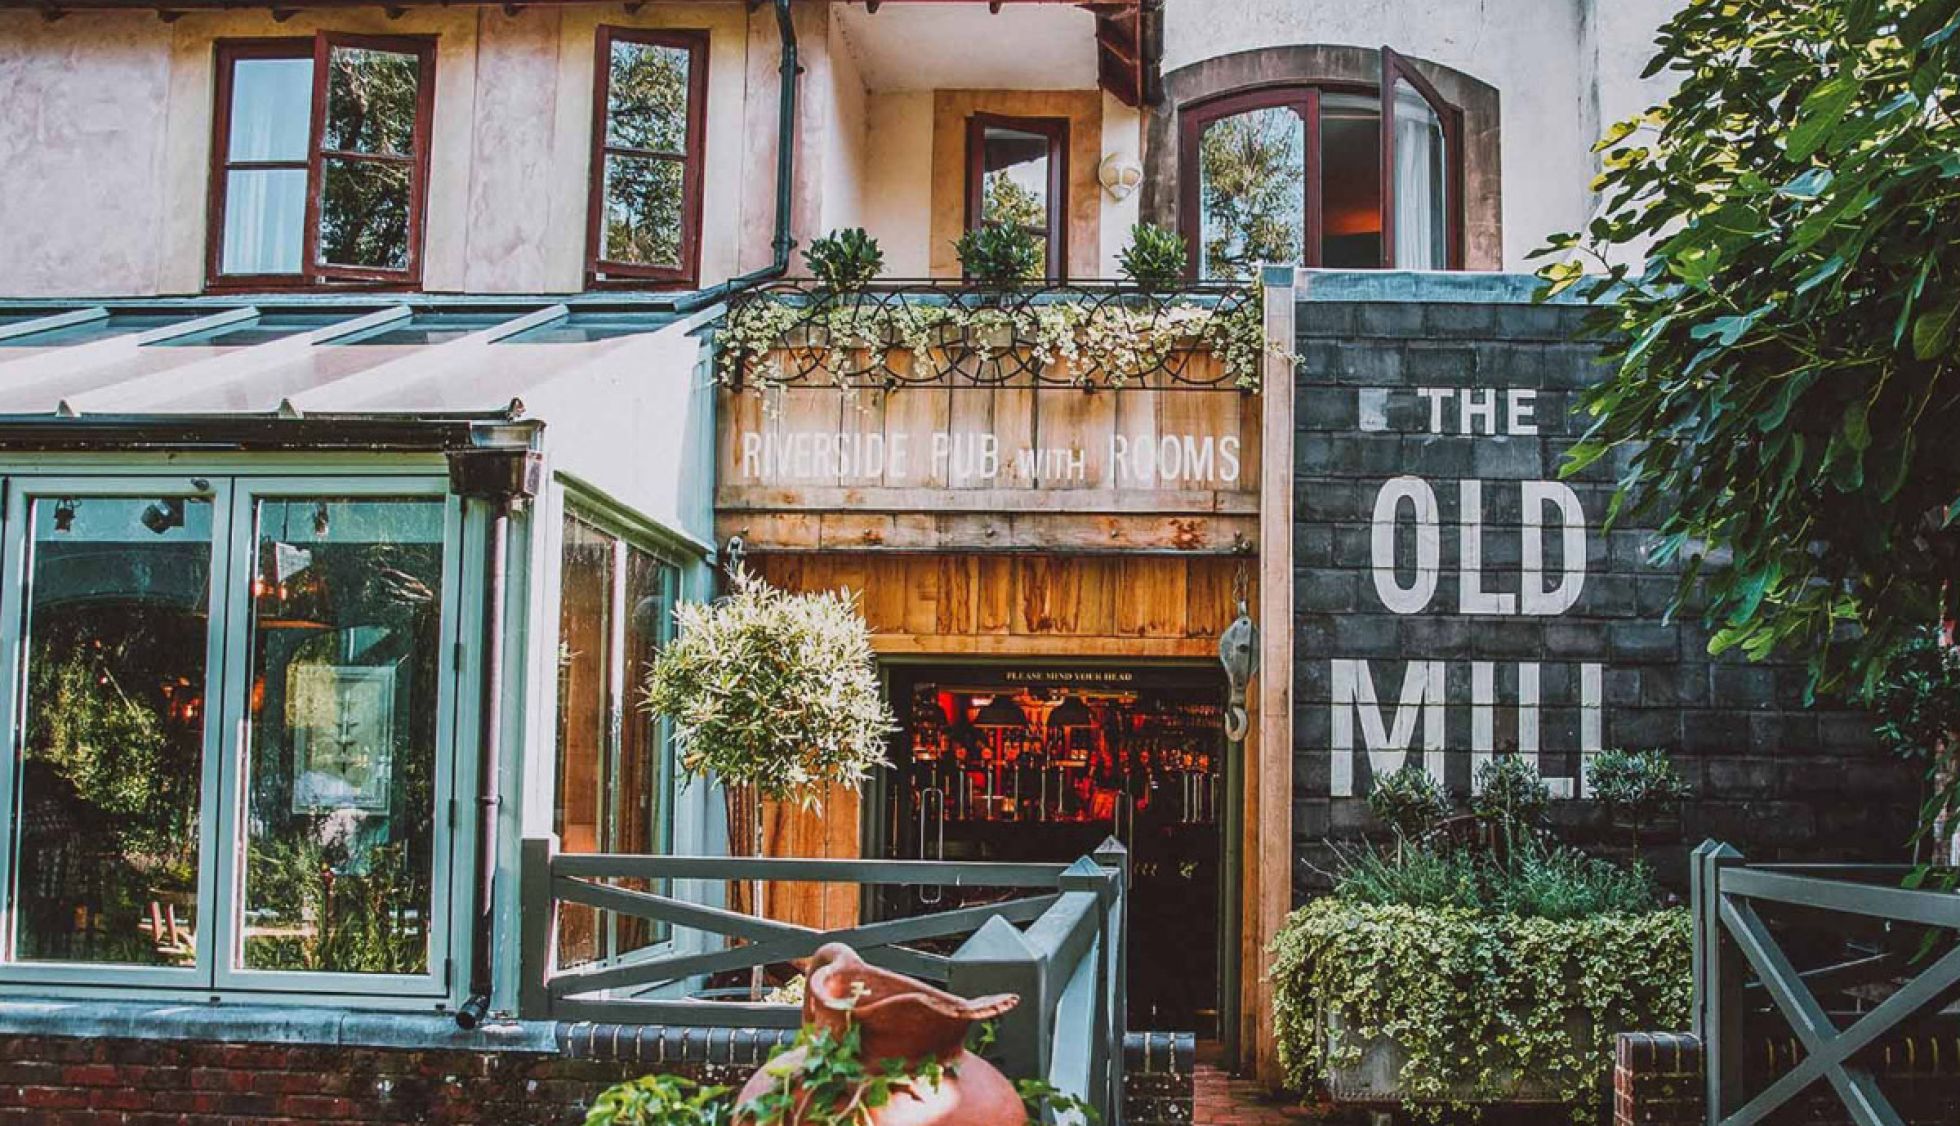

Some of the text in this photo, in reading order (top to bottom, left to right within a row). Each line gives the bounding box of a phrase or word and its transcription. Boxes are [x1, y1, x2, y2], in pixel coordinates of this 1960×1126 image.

[1417, 387, 1538, 436] THE
[742, 431, 1240, 482] RIVERSIDE PUB WITH ROOMS
[1370, 475, 1587, 616] OLD
[1006, 671, 1133, 681] PLEASE MIND YOUR HEAD
